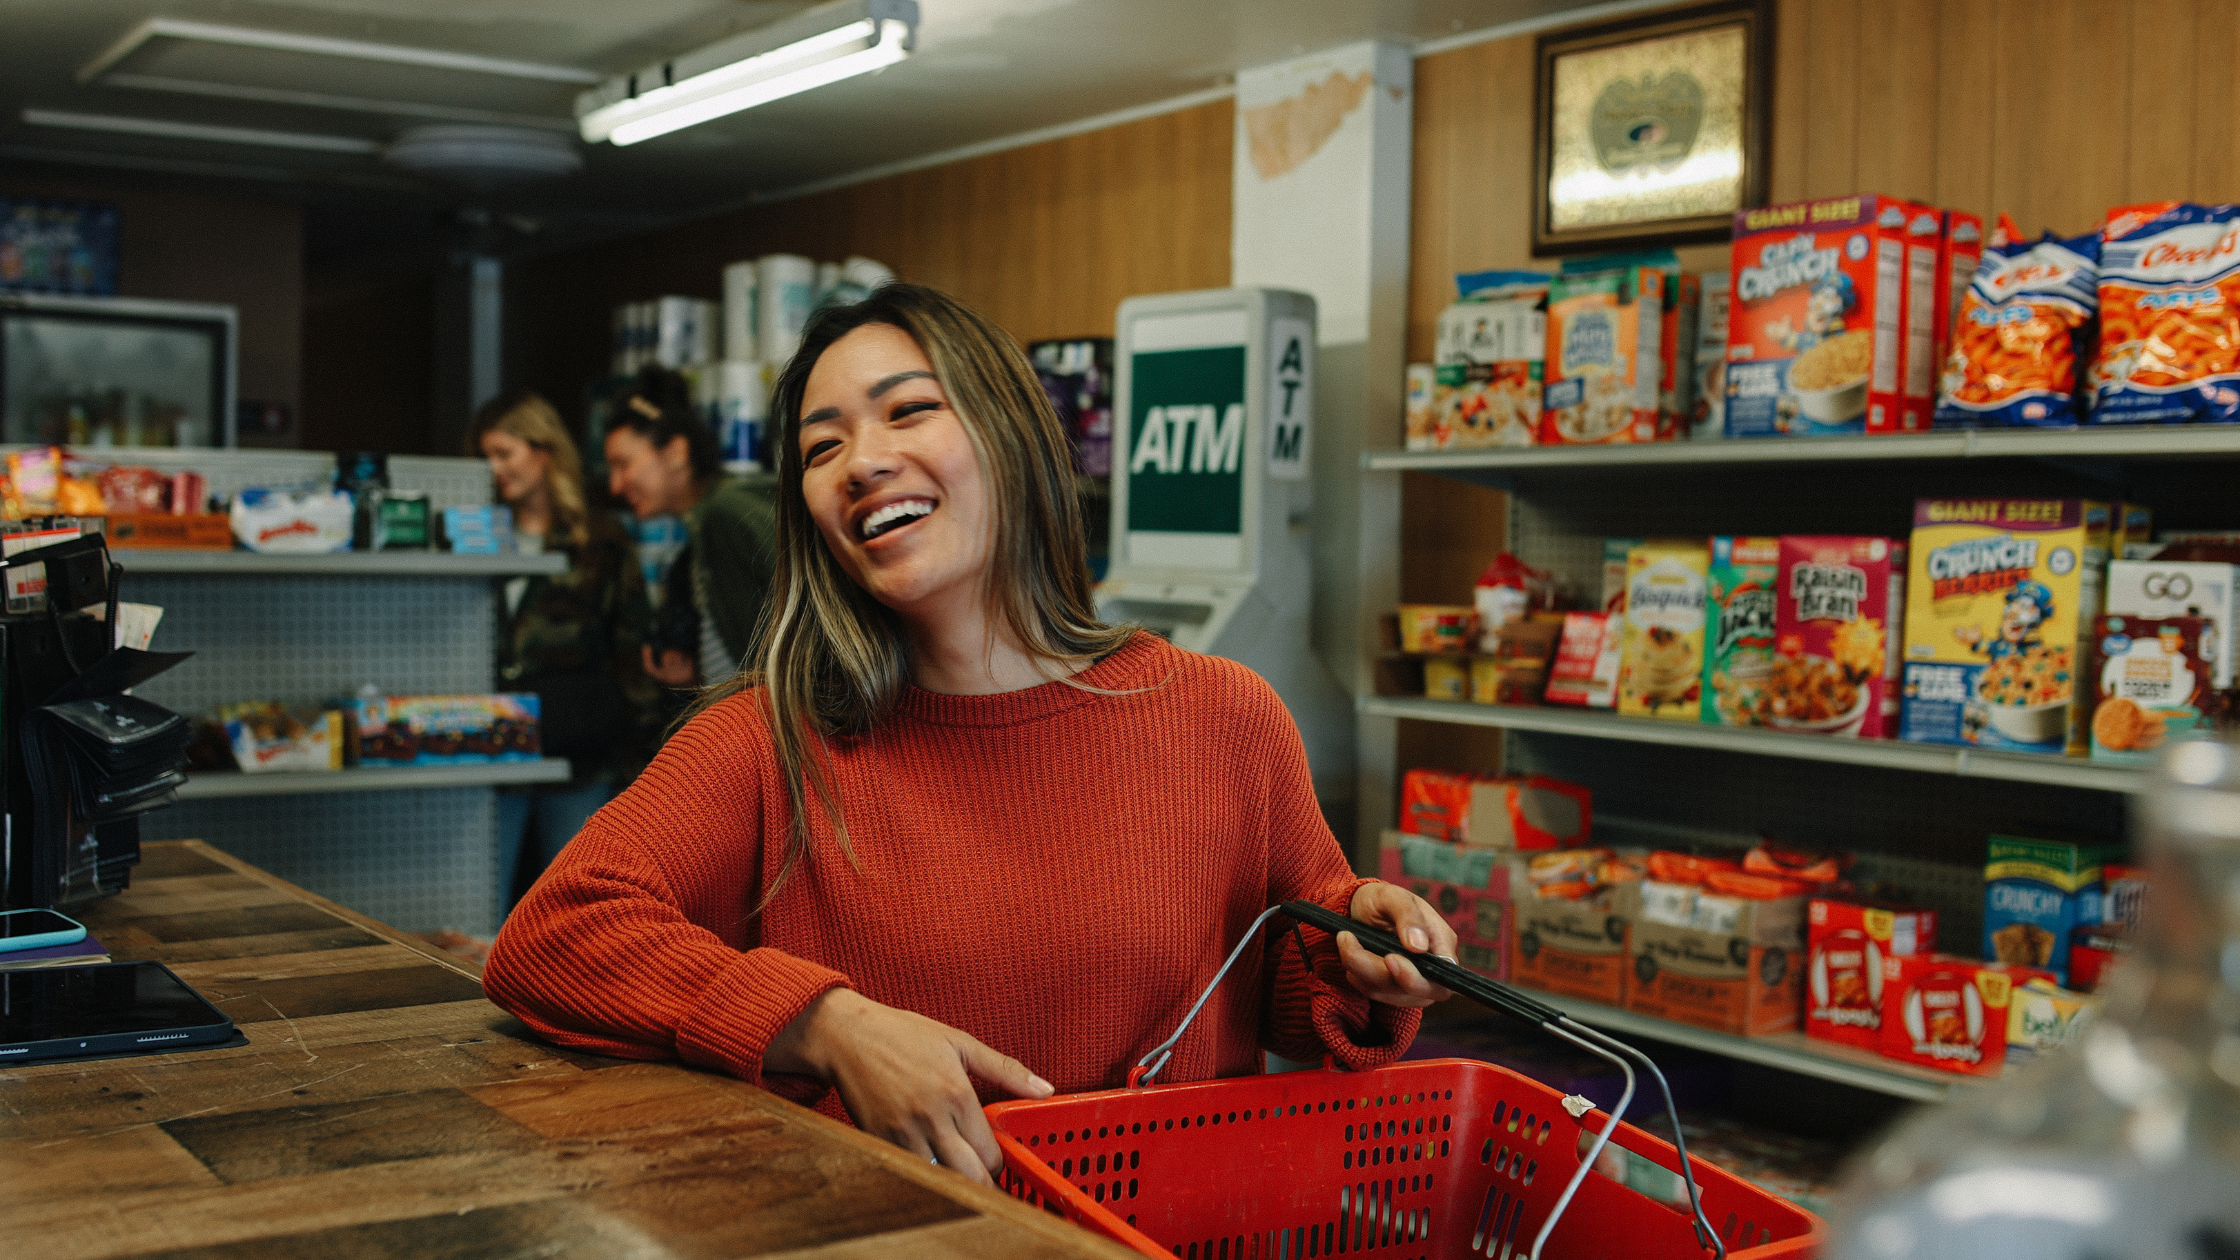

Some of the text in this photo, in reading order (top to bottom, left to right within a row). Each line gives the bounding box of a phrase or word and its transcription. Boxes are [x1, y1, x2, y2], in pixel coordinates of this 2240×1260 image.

[1745, 197, 1860, 230] GIANT SIZE!
[1738, 247, 1840, 300] CRUNCH
[1274, 336, 1302, 460] ATM
[1131, 404, 1243, 474] ATM
[1927, 501, 2063, 525] GIANT SIZE!
[1929, 540, 2038, 579] CRUNCH
[1793, 566, 1866, 596] Raisin
[2144, 571, 2193, 602] GO
[1801, 591, 1857, 618] Bran
[1907, 665, 1964, 684] FREE
[1991, 884, 2064, 917] CRUNCHY
